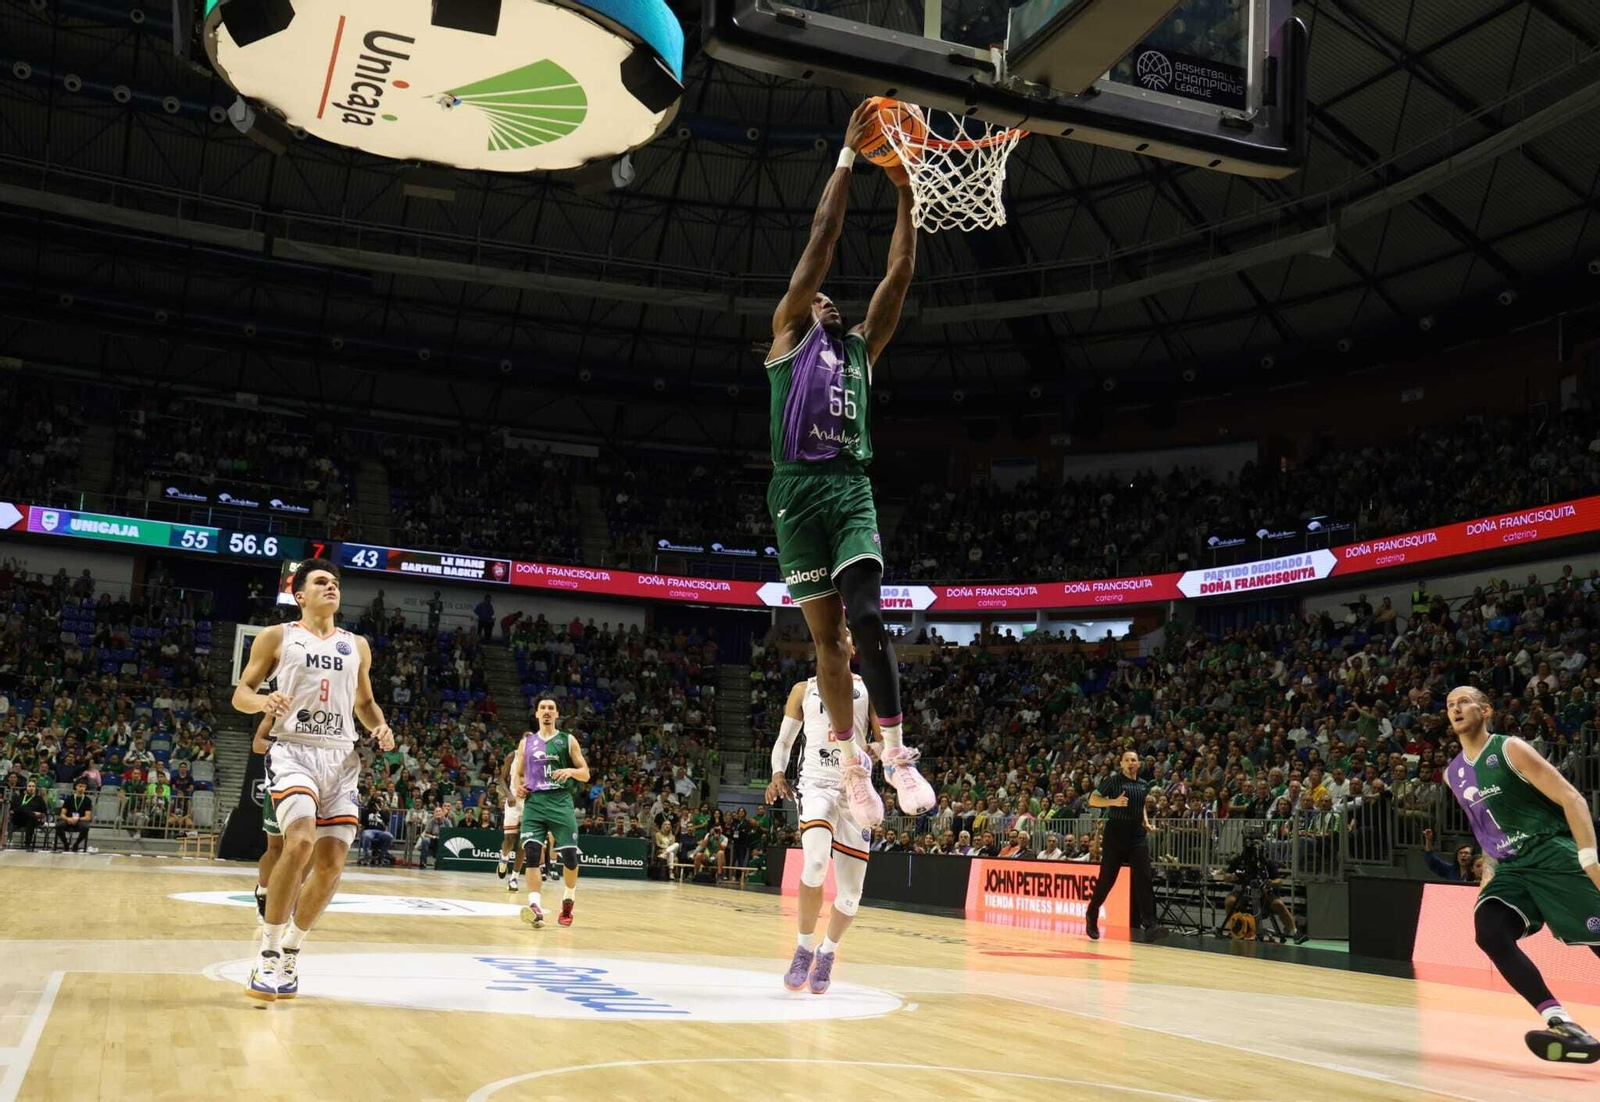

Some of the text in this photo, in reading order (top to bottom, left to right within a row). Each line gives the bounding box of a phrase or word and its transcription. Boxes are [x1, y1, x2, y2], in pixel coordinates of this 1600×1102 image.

[331, 30, 415, 126] Unicaja
[1175, 62, 1236, 83] BASKETBALL
[1175, 71, 1243, 96] CHAMPIONS
[1175, 82, 1212, 98] LEAGUE
[830, 385, 857, 419] 55
[70, 518, 140, 538] UNICAJA
[1467, 505, 1576, 535] DOÑA FRANCISQUITA
[181, 530, 209, 549] 55
[229, 533, 278, 557] 56.6
[1346, 532, 1438, 558] DOÑA FRANCISQUITA
[1503, 529, 1537, 543] catering
[312, 543, 325, 559] 7
[351, 549, 379, 568] 43
[1375, 553, 1405, 565] catering
[401, 562, 485, 579] SARTHE BASKET
[440, 557, 485, 569] LE MANS
[516, 562, 610, 581] DOÑA FRANCISQUITA
[1203, 555, 1312, 582] PARTIDO DEDICADO A
[548, 578, 578, 589] catering
[638, 575, 731, 591] DOÑA FRANCISQUITA
[1064, 579, 1153, 593] DOÑA FRANCISQUITA
[1200, 566, 1316, 594] DOÑA FRANCISQUITA
[669, 589, 699, 599] catering
[946, 586, 1038, 597] DOÑA FRANCISQUITA
[1095, 593, 1123, 602] catering
[977, 598, 1007, 608] catering
[306, 653, 343, 671] MSB
[319, 678, 330, 702] 9
[543, 764, 552, 777] 14
[820, 758, 840, 767] FINA
[1486, 809, 1501, 829] 1
[472, 849, 502, 859] Unica
[580, 853, 643, 867] Unicaja Banco
[984, 869, 1098, 901] JOHN PETER FITNES
[984, 894, 1106, 919] TIENDA FITNESS MARBEA
